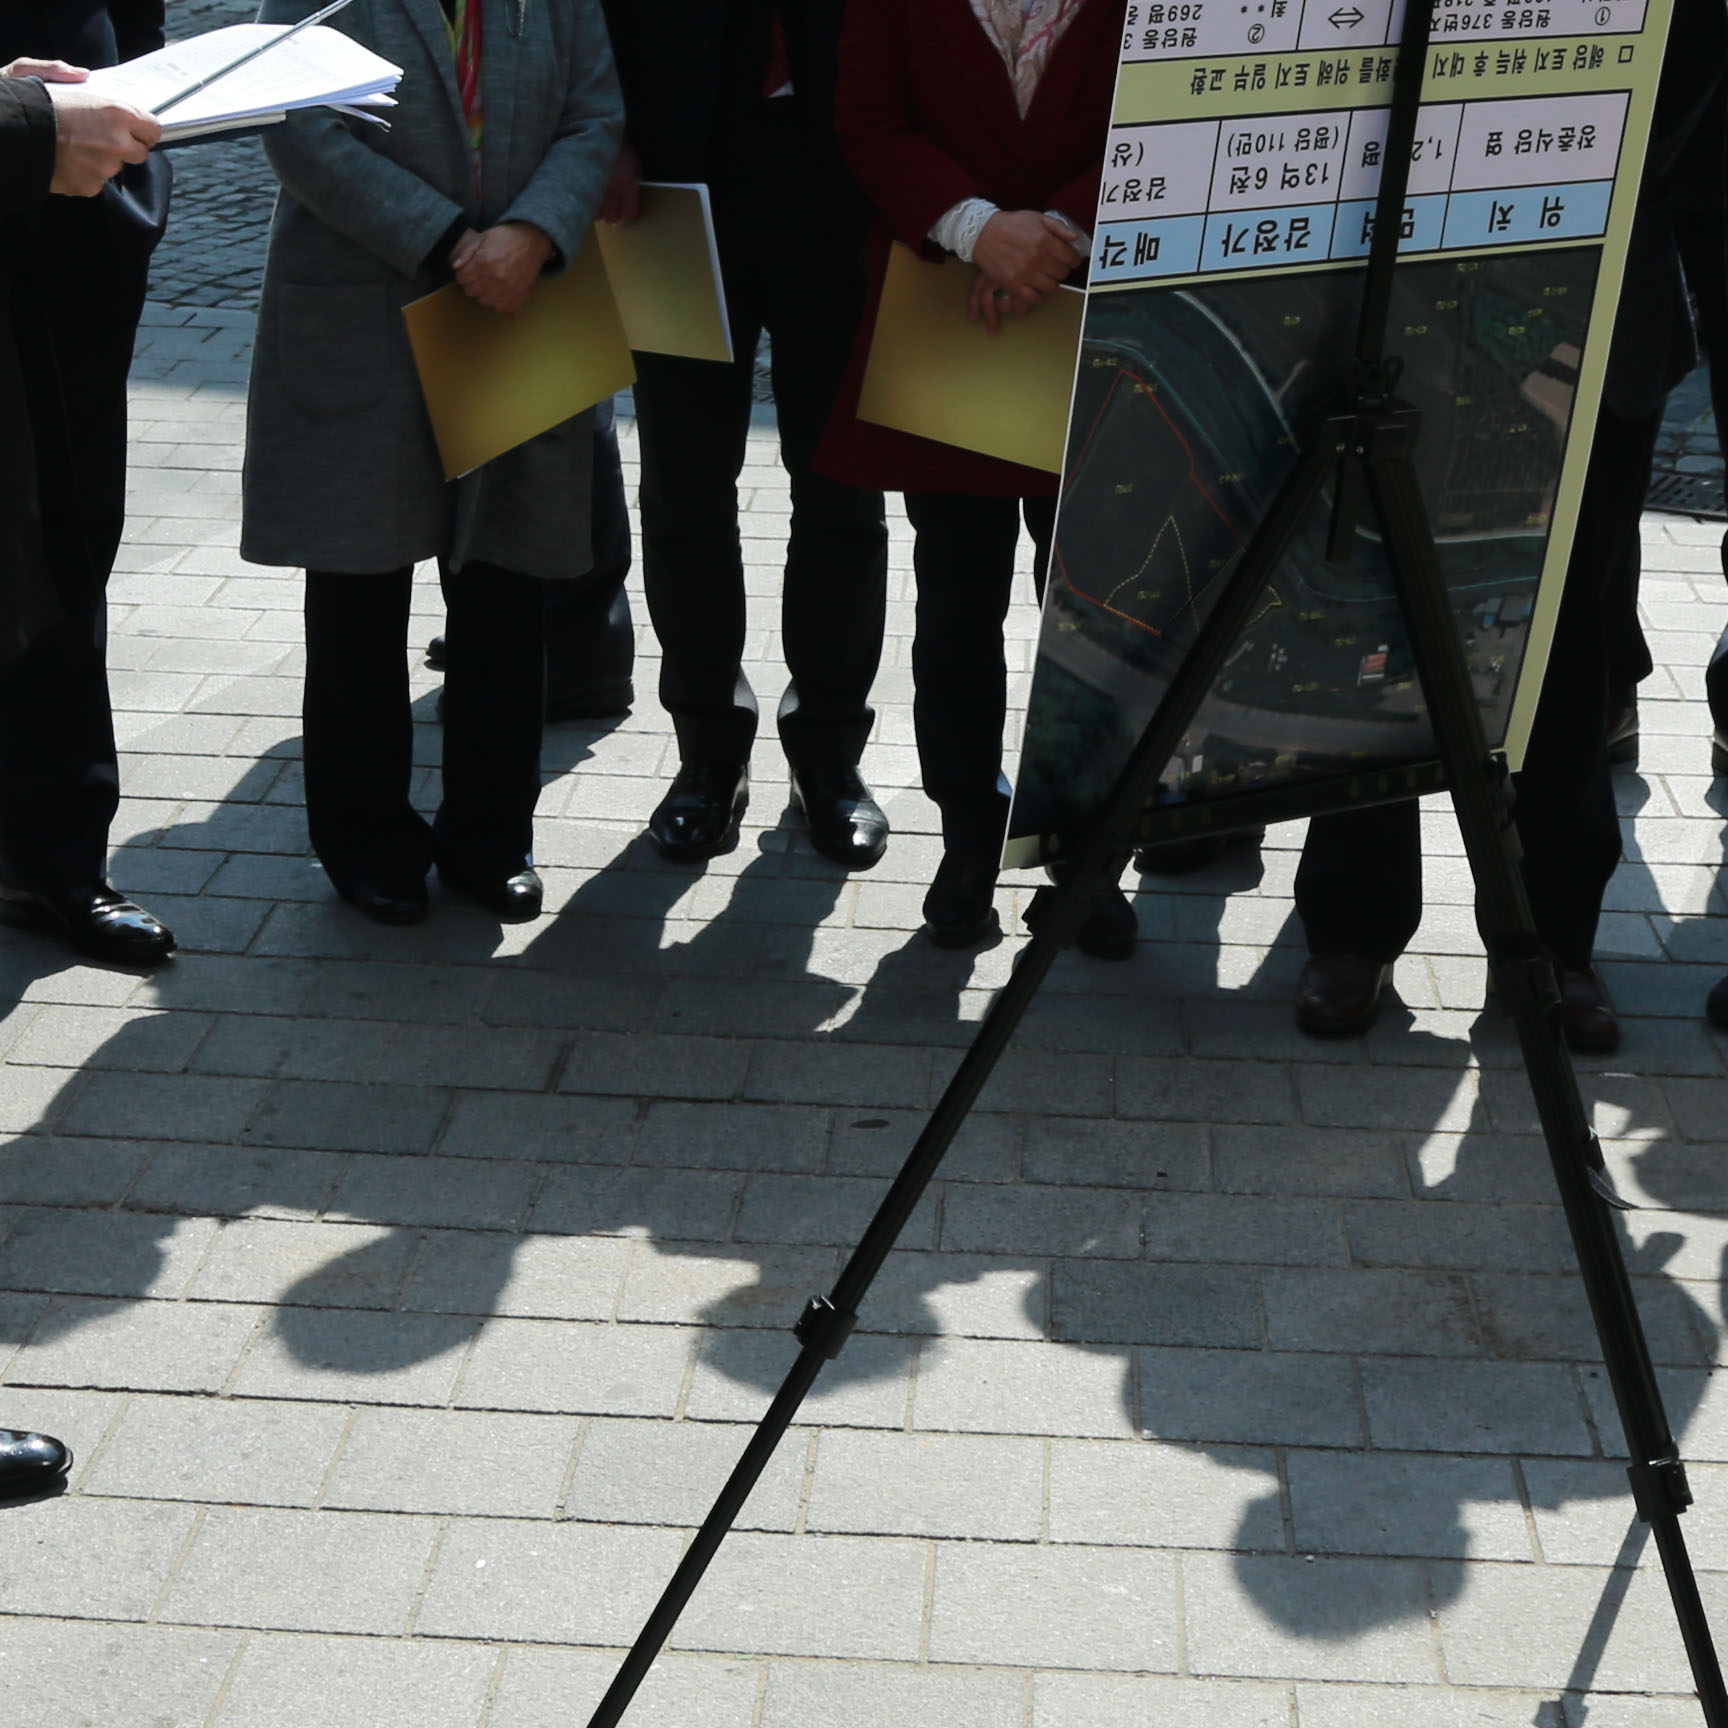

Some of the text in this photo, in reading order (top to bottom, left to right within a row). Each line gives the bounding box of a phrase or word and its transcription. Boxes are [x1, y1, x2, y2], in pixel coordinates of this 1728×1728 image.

[1148, 3, 1204, 26] 269평
[1500, 9, 1552, 30] 원당동
[1142, 27, 1197, 50] 원당동
[1432, 51, 1466, 79] 대지
[1472, 50, 1490, 77] 후
[1496, 48, 1528, 75] 취득
[1534, 47, 1568, 73] 토지
[1572, 44, 1604, 71] 해당
[1190, 67, 1227, 96] 교환
[1233, 63, 1267, 92] 일부
[1274, 62, 1311, 90] 토지
[1316, 58, 1351, 87] 위해
[1227, 125, 1340, 159] (평당 110만)
[1484, 124, 1596, 157] 장춘식당 옆
[1228, 162, 1329, 195] 13억 6천
[1098, 231, 1161, 270] 매각
[1221, 216, 1312, 258] 감정가
